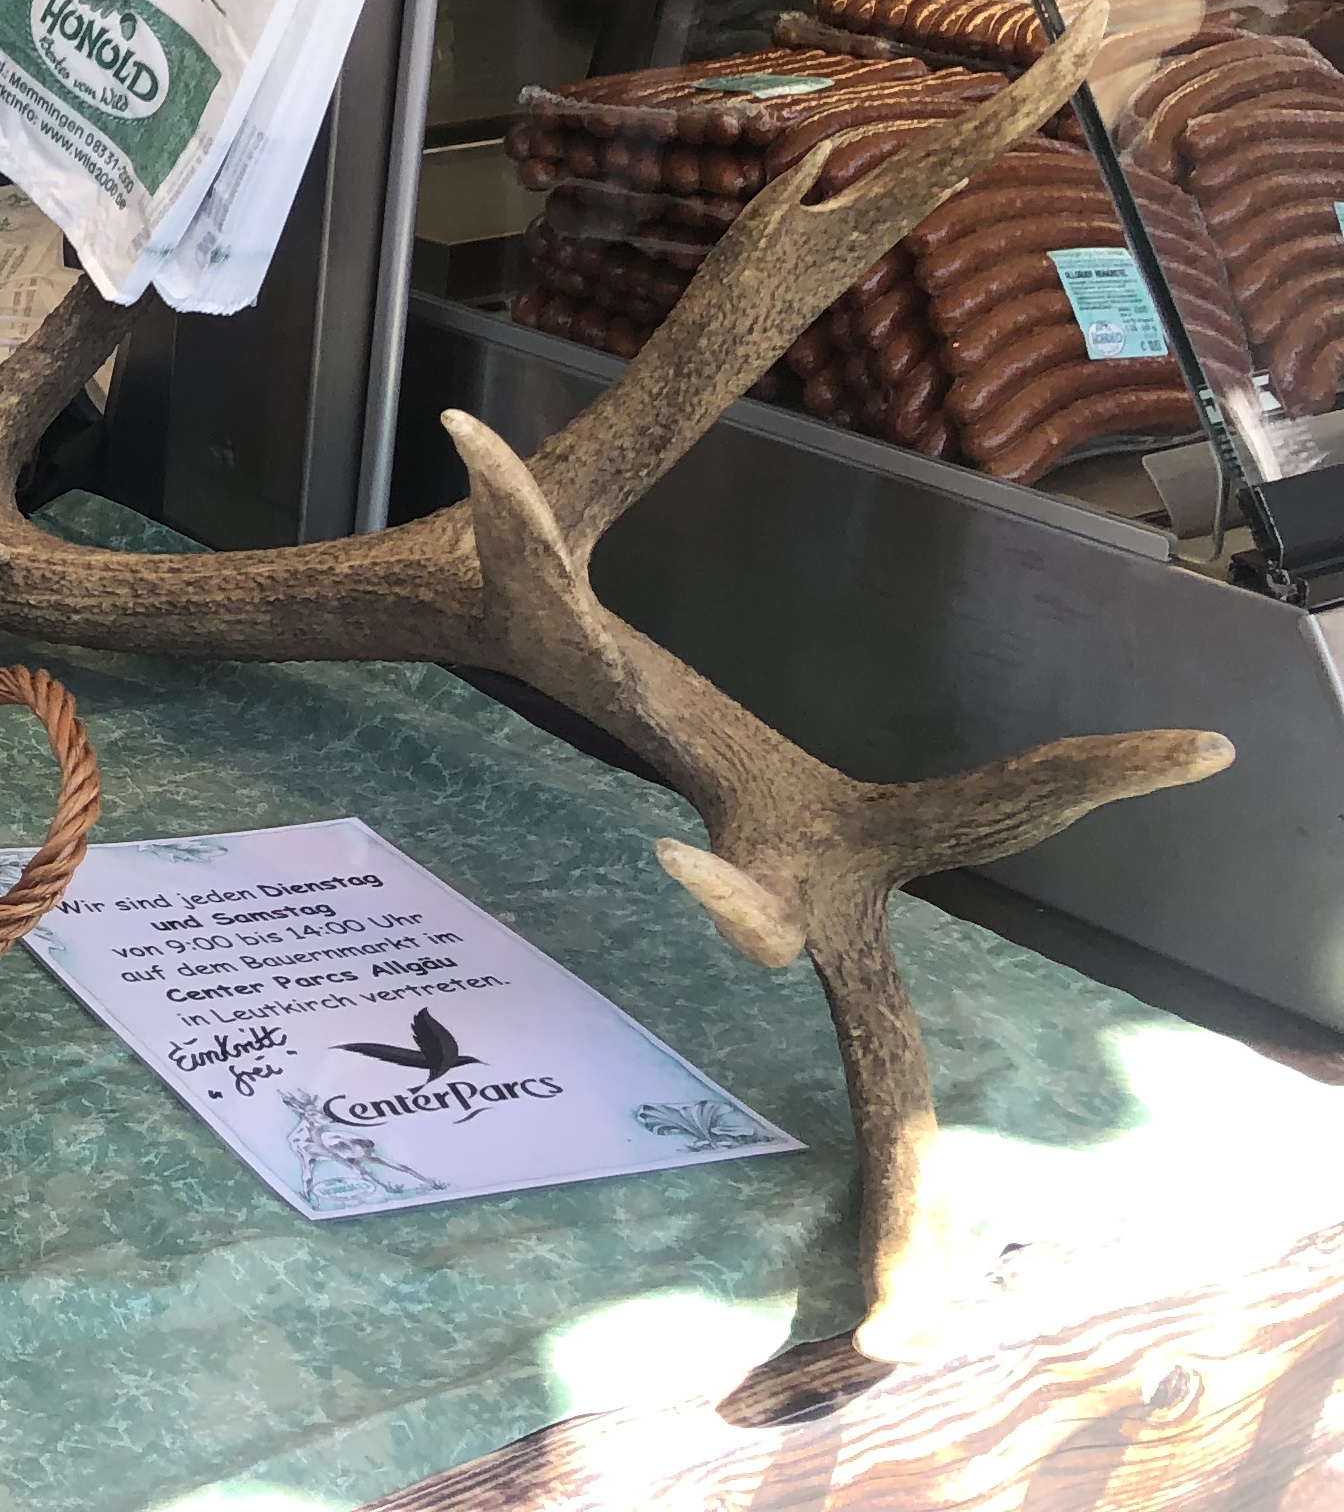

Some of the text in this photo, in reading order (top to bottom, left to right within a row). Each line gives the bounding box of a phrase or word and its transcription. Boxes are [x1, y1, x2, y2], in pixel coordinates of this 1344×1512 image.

[10, 72, 85, 140] Memmingen
[74, 78, 97, 100] vom
[99, 86, 129, 112] Wild
[40, 119, 127, 211] www.wild2000.de
[56, 873, 385, 915] Wir sind jeden Dienstag
[150, 903, 337, 931] und Samstag
[112, 911, 425, 958] von 9:00 bis 14:00 Uhr
[121, 930, 464, 983] auf dem Bauernmarkt im
[166, 955, 458, 1003] Center Parcs Allgäu
[176, 973, 512, 1027] in Leutkirch vertreten.
